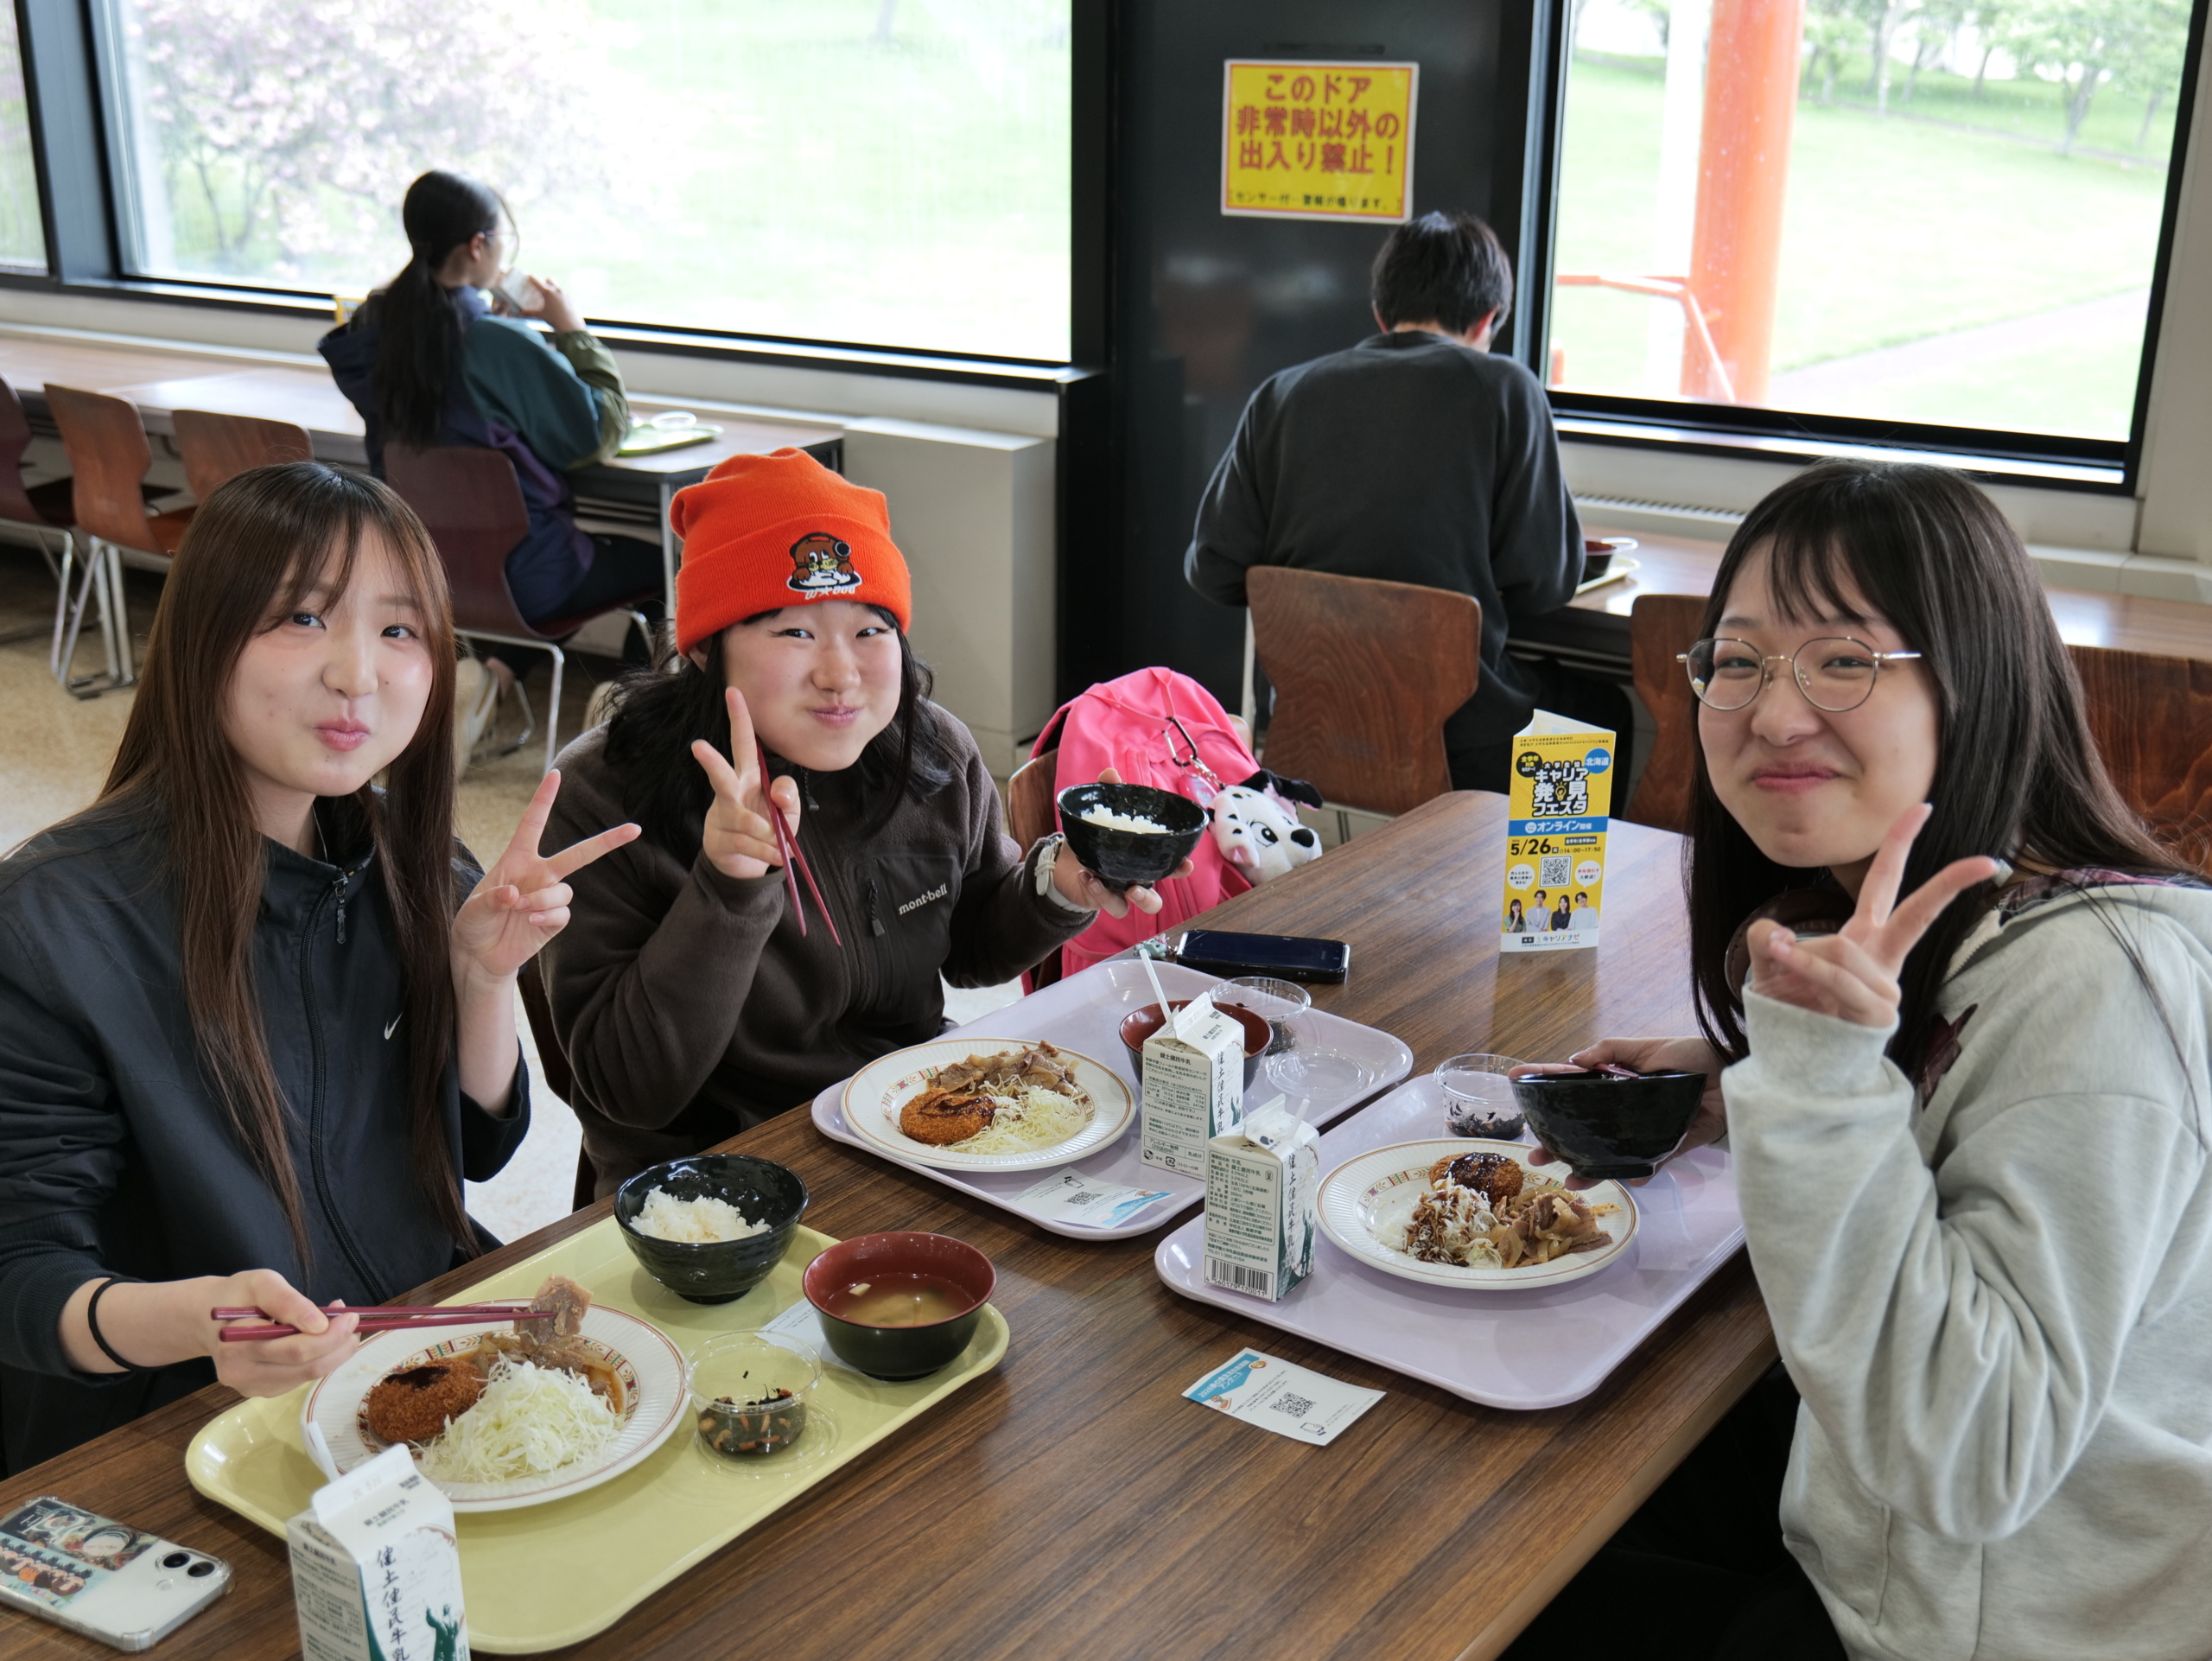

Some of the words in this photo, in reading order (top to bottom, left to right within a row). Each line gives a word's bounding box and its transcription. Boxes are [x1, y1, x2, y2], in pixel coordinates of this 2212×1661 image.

[1265, 73, 1371, 103] このドア
[1236, 105, 1400, 139] 非常時以外の
[1544, 760, 1581, 769] 大学生協
[1586, 756, 1609, 767] 北海道
[1534, 767, 1590, 783] キャリア
[1534, 780, 1587, 803] 発見
[1533, 800, 1587, 816] フェスタ
[1536, 821, 1592, 832] オンライン開催
[1510, 838, 1552, 856] 5/26
[1542, 933, 1580, 943] キャリアナビ
[1214, 1279, 1237, 1289] 560179
[1241, 1286, 1265, 1296] 170011
[1218, 1371, 1243, 1390] アンケート
